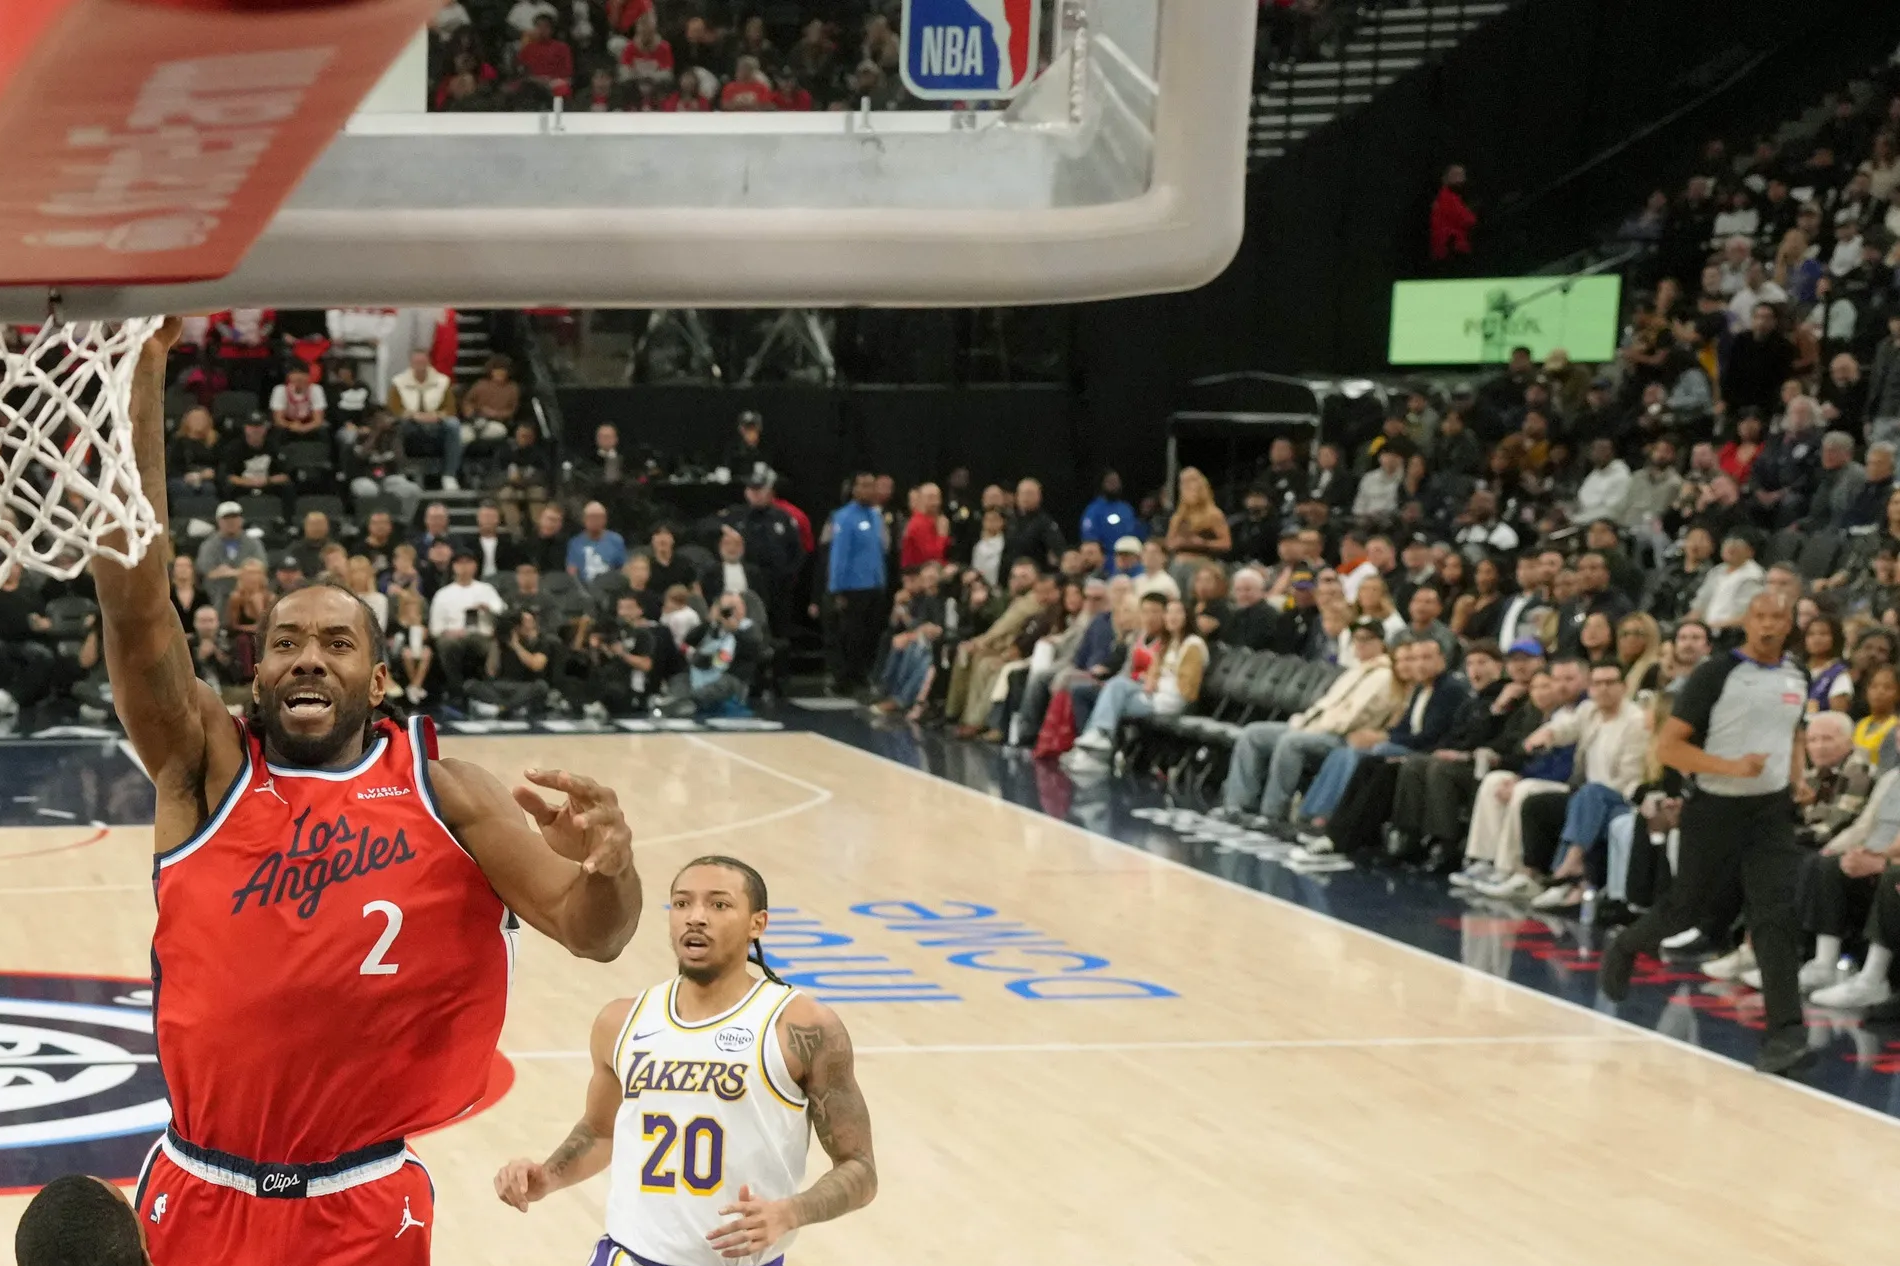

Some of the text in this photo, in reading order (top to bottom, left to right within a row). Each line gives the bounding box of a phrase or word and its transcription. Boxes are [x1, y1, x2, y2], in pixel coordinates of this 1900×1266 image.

[920, 26, 984, 76] NBA
[357, 788, 411, 799] RWANDA
[367, 786, 398, 794] VISIT
[287, 805, 356, 859] Los
[231, 826, 416, 919] Angeles
[359, 900, 404, 975] 2
[718, 1033, 752, 1045] bibigo
[624, 1050, 750, 1101] LAKERS
[640, 1112, 725, 1196] 20
[262, 1172, 301, 1192] Clips
